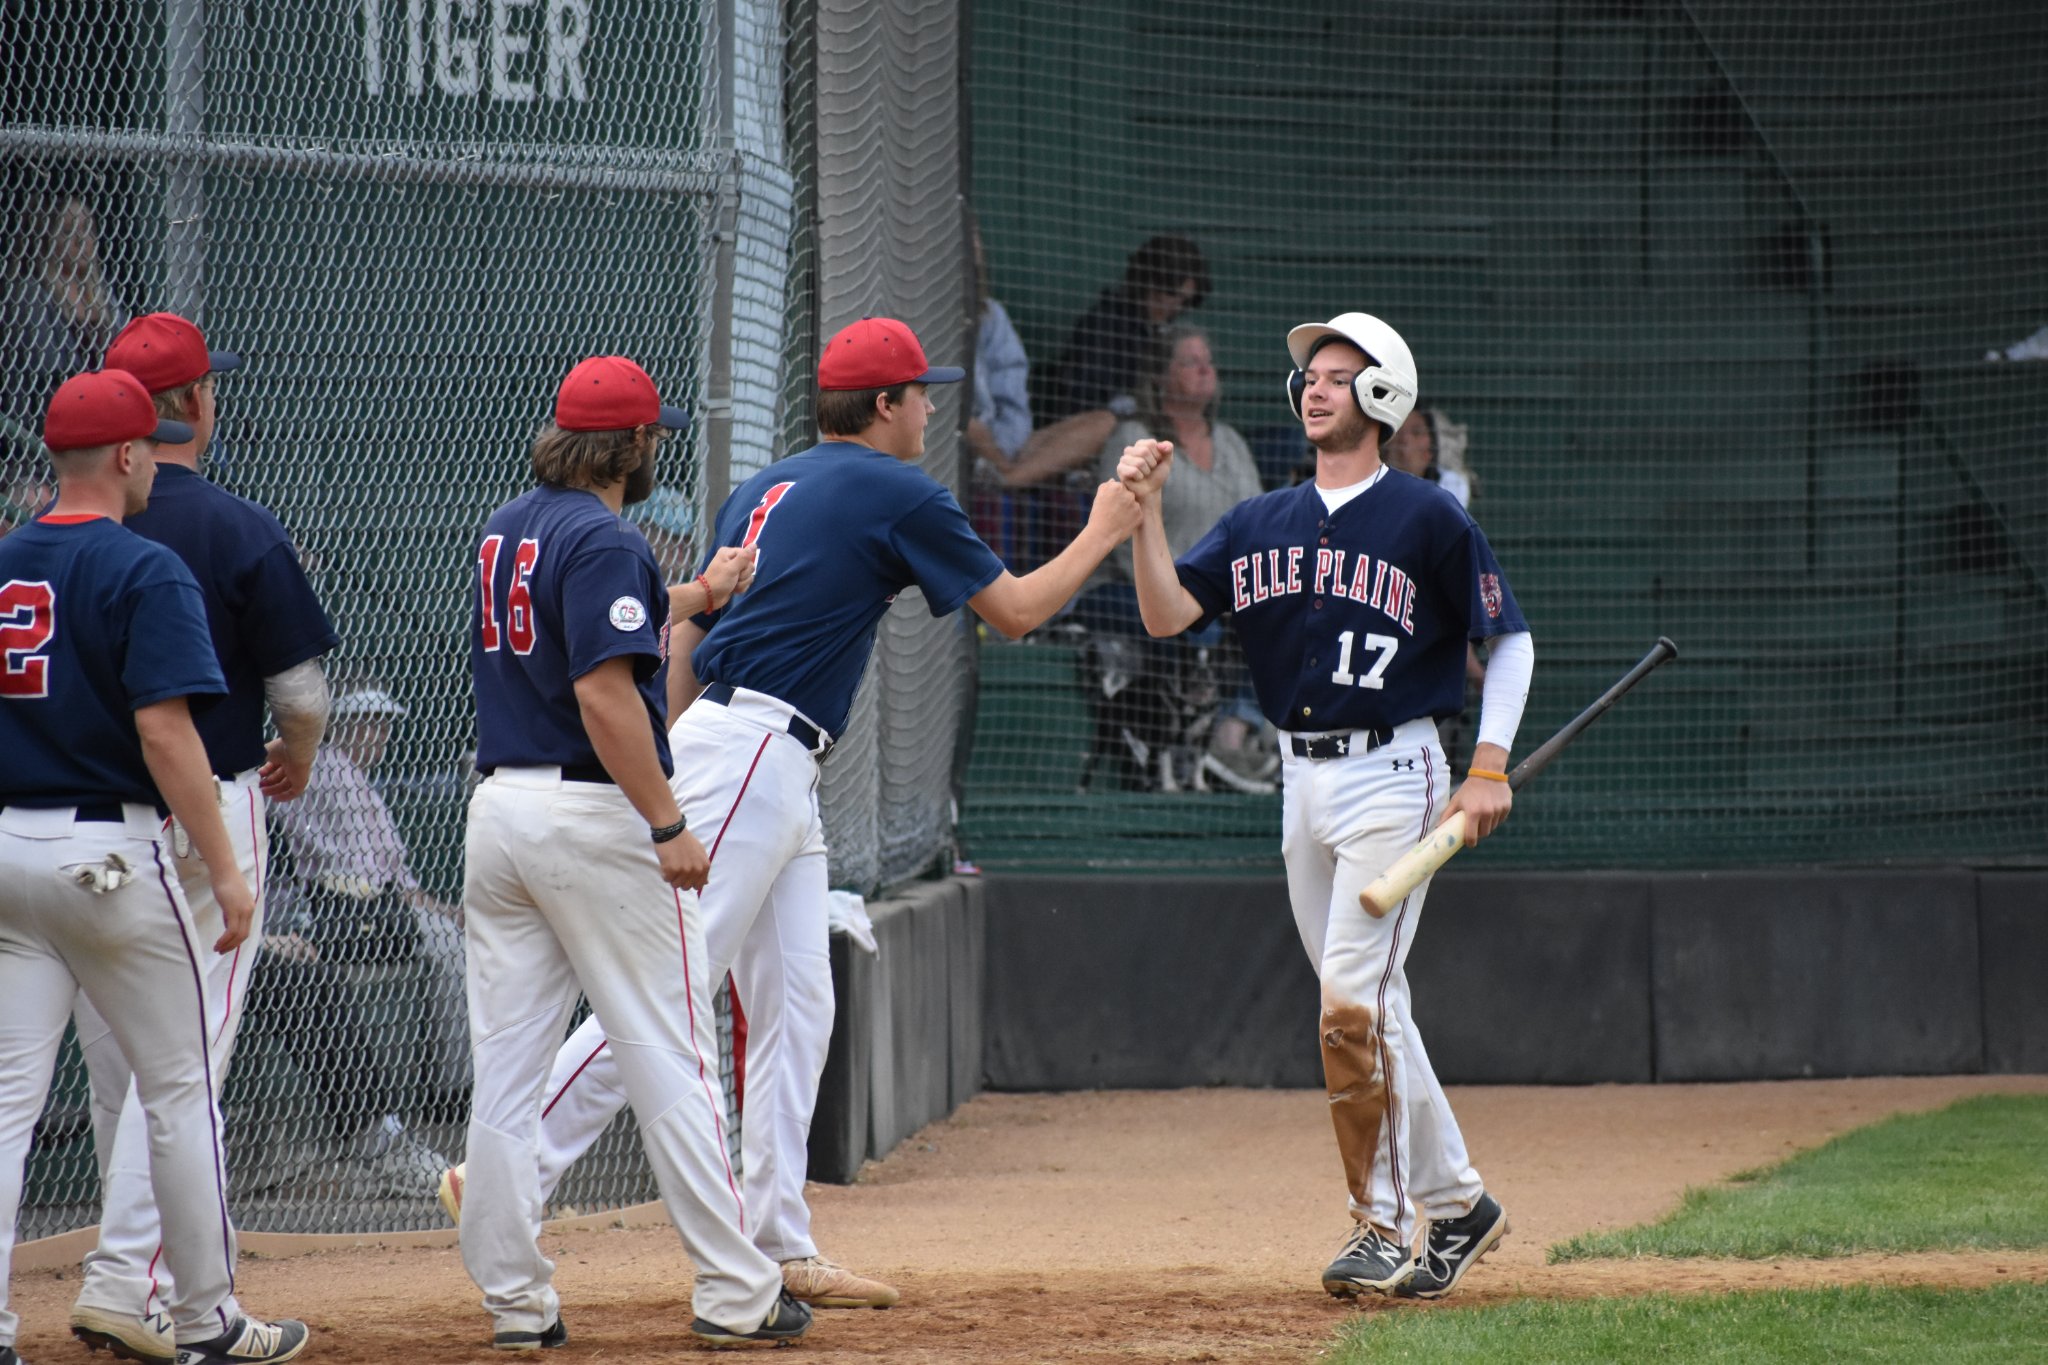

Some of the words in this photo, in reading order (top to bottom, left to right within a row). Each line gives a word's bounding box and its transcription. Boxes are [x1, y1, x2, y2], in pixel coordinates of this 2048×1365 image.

[0, 579, 56, 698] 2
[477, 535, 540, 655] 16
[1313, 548, 1417, 636] PLAINE
[1332, 630, 1399, 690] 17
